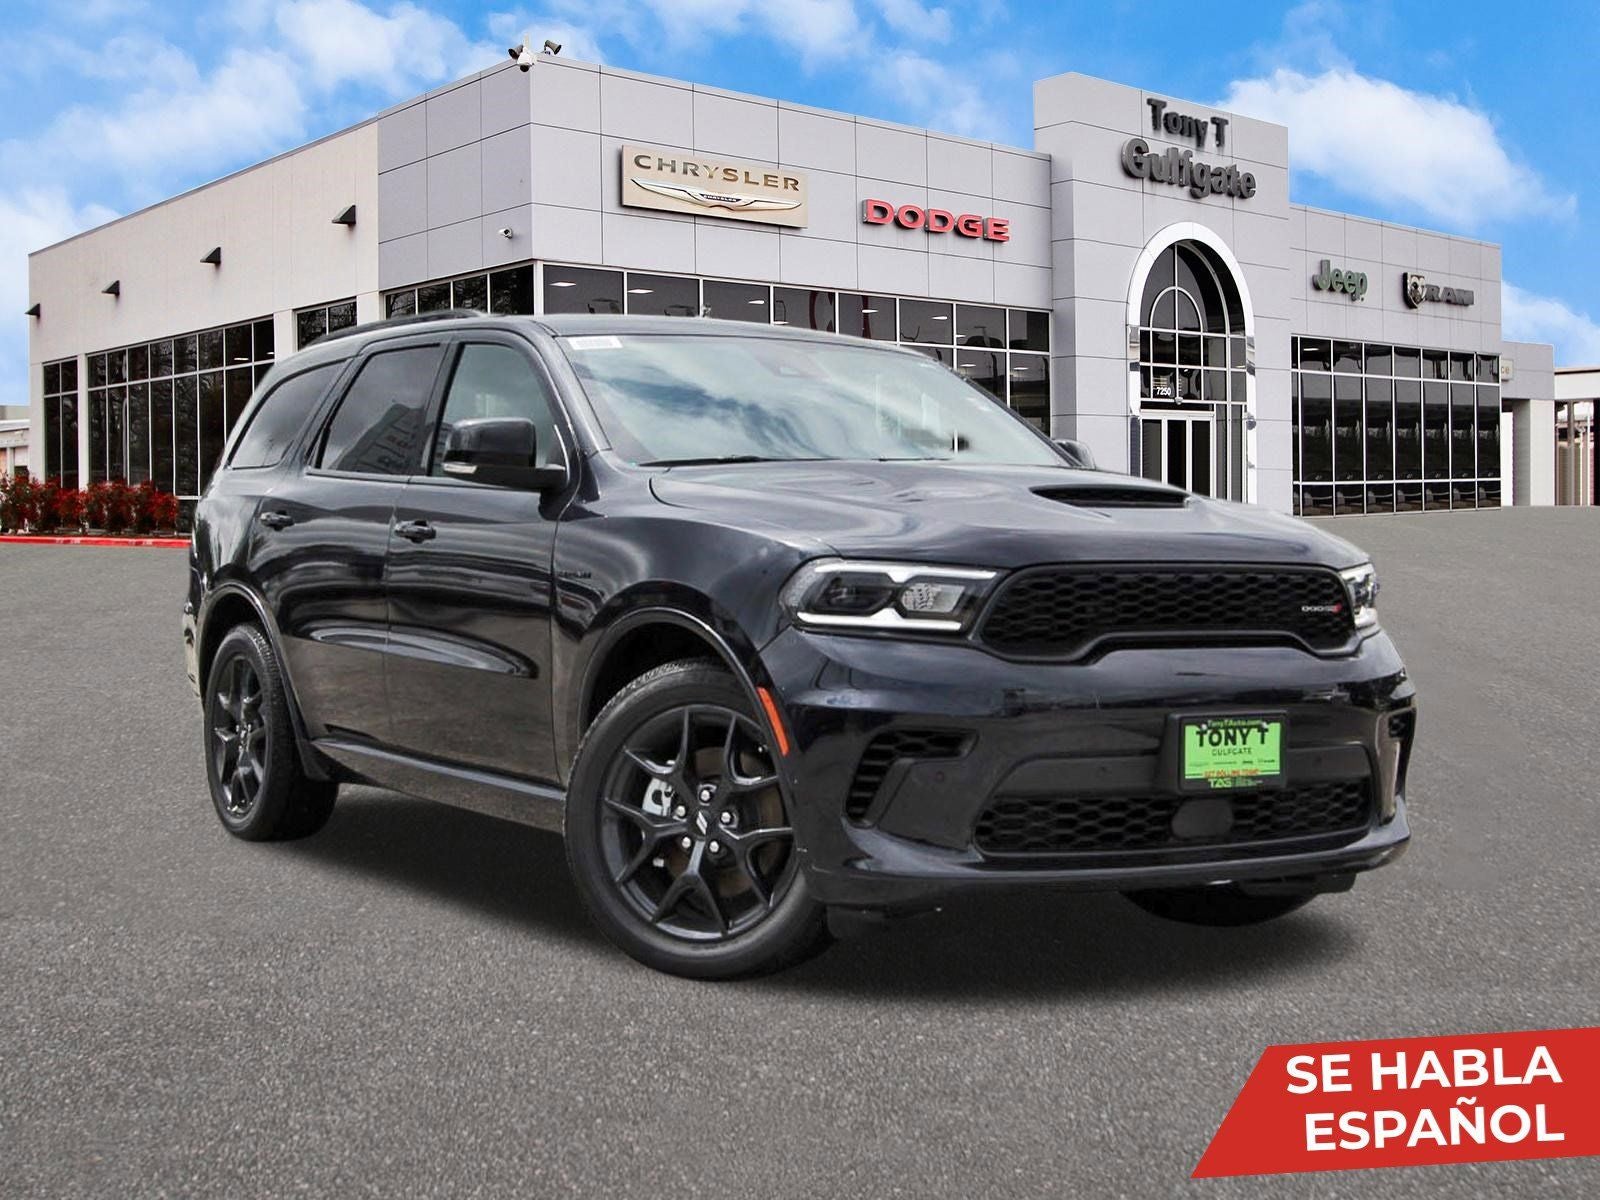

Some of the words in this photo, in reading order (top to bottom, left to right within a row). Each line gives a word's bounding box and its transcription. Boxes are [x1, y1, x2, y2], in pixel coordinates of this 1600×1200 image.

[1146, 98, 1208, 147] Tony
[1210, 116, 1229, 147] T
[633, 154, 800, 192] CHRYSLER
[1121, 138, 1257, 199] Gulfgate
[863, 198, 1010, 242] DODGE
[1312, 259, 1368, 301] Jeep
[1425, 284, 1475, 306] RAM
[1156, 387, 1172, 396] 7250
[1196, 727, 1251, 747] TONY
[1257, 724, 1269, 745] T
